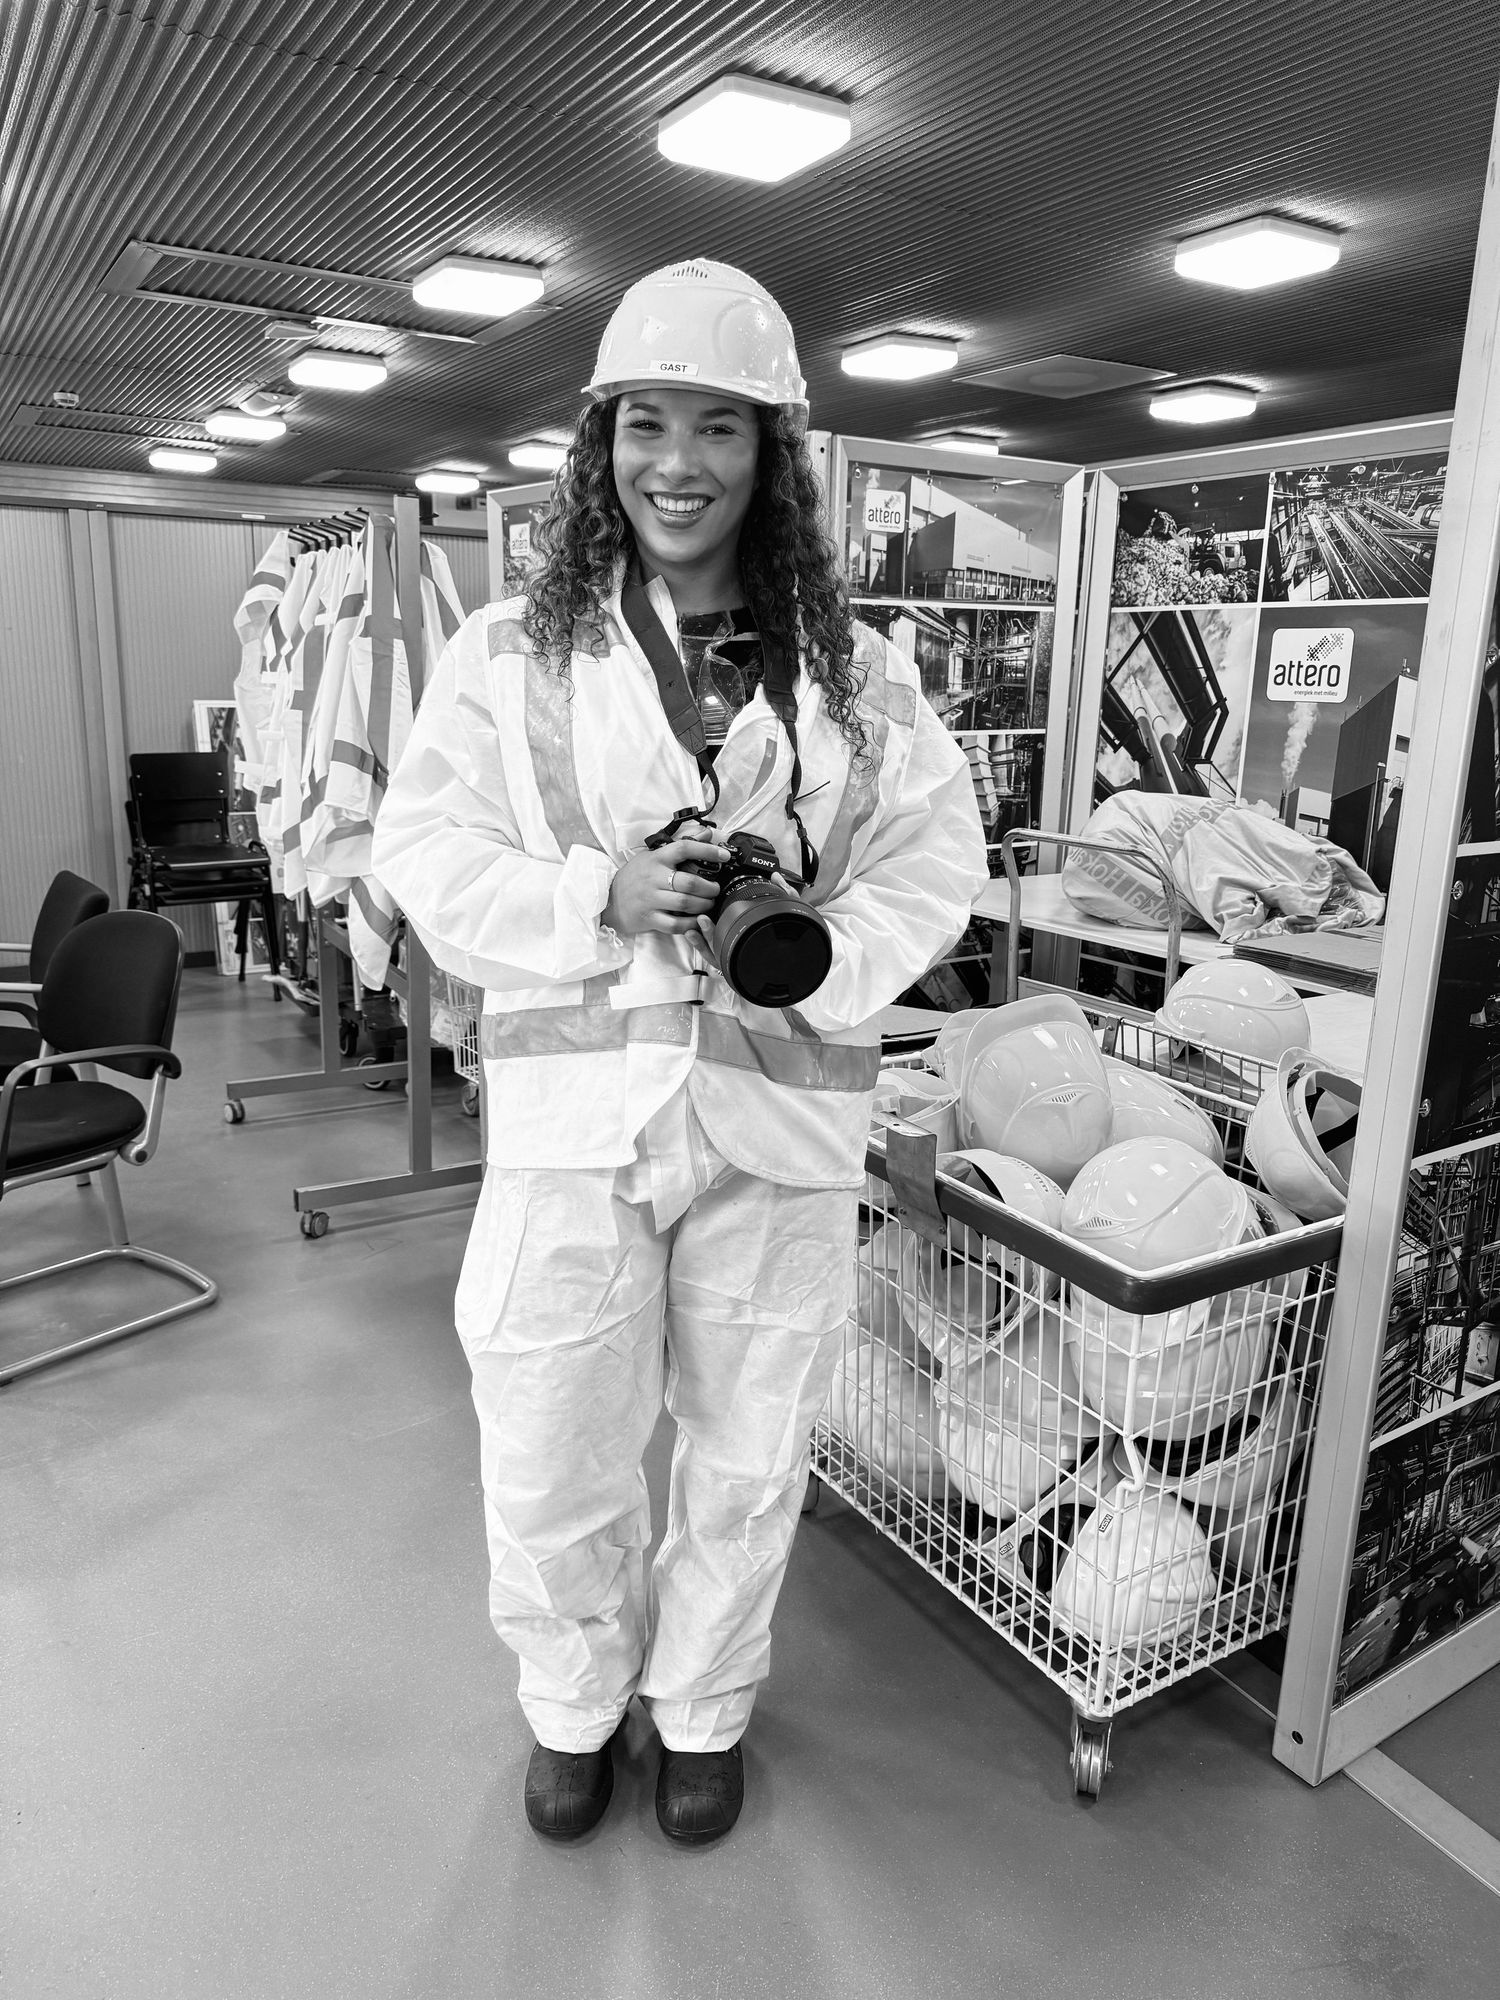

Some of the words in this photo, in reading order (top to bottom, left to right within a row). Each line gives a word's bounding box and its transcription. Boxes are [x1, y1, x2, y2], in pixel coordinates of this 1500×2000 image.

[660, 363, 688, 373] GAST
[868, 507, 901, 524] attero
[1273, 660, 1341, 687] attero
[751, 856, 776, 868] SONY
